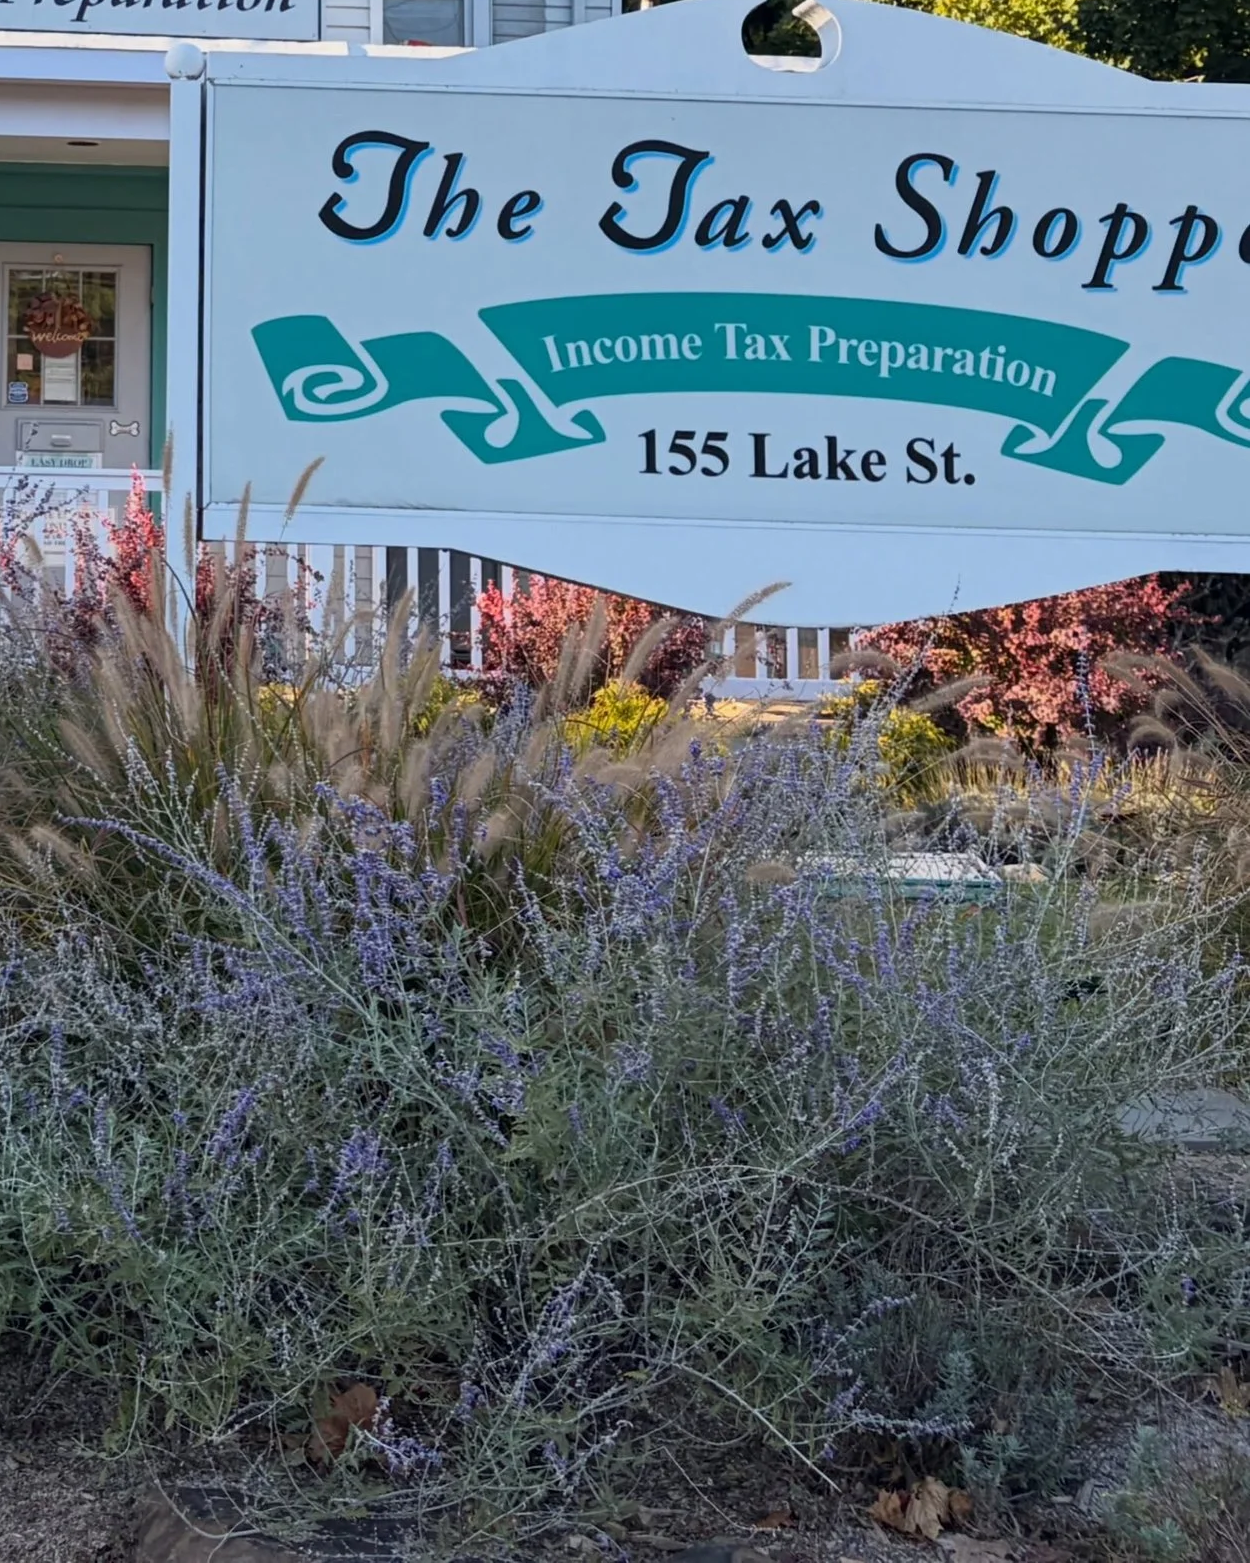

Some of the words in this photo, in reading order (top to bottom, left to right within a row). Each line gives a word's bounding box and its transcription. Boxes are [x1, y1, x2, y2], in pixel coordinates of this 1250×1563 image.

[317, 130, 544, 243] The
[597, 139, 823, 255] Tax
[873, 152, 1250, 292] Shopp
[543, 333, 703, 373] Income
[714, 323, 791, 361] Tax
[808, 326, 1057, 397] Preparation
[638, 428, 730, 477] 155
[748, 432, 887, 483] Lake
[906, 437, 977, 486] St.
